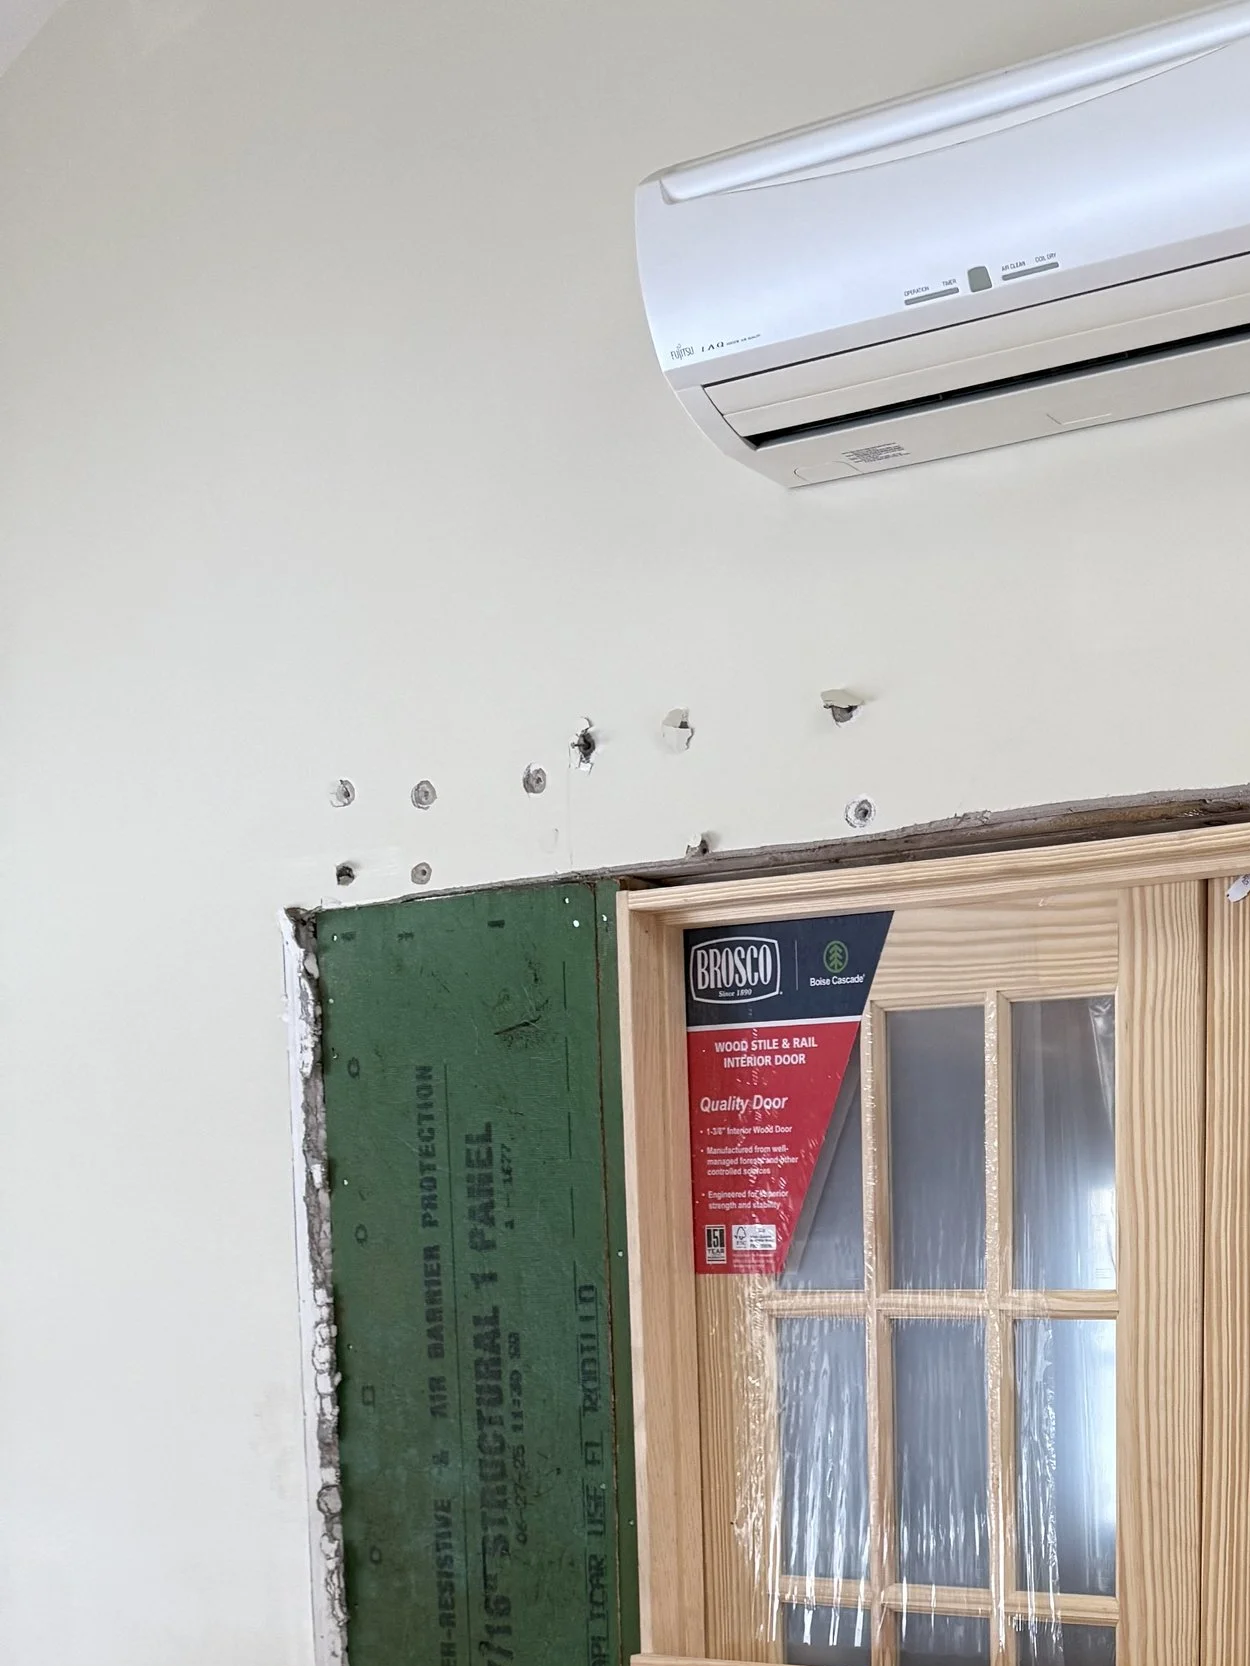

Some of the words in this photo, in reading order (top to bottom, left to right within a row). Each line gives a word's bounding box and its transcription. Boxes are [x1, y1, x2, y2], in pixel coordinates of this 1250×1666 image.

[904, 286, 930, 298] OPERATION
[670, 344, 694, 360] FUJITSU
[697, 944, 773, 990] BROSCO
[810, 976, 830, 987] Boise
[718, 990, 736, 998] Since
[736, 988, 752, 997] 1890
[714, 1040, 748, 1053] WOOD
[751, 1038, 778, 1051] STILE
[782, 1038, 790, 1050] &
[794, 1036, 818, 1048] RAIL
[724, 1055, 772, 1068] INTERIOR
[774, 1053, 806, 1065] DOOR
[700, 1096, 749, 1114] Quality
[752, 1094, 788, 1110] Door
[726, 1126, 752, 1135] Interior
[752, 1125, 774, 1134] Wood
[414, 1065, 439, 1228] PROTECTION
[706, 1146, 753, 1155] Manufactured
[772, 1144, 788, 1152] well-
[707, 1158, 738, 1166] managed
[780, 1155, 798, 1164] other
[707, 1167, 742, 1176] controlled
[742, 1167, 771, 1175] sources
[464, 1120, 497, 1252] PANEL
[708, 1190, 746, 1200] Engineered
[708, 1202, 736, 1210] strength
[738, 1201, 752, 1209] and
[752, 1200, 781, 1210] stability
[469, 1272, 498, 1288] 1
[422, 1244, 445, 1360] BARRIER
[428, 1376, 448, 1419] AIR
[472, 1305, 510, 1556] STRUCTURAL
[584, 1485, 605, 1537] USE
